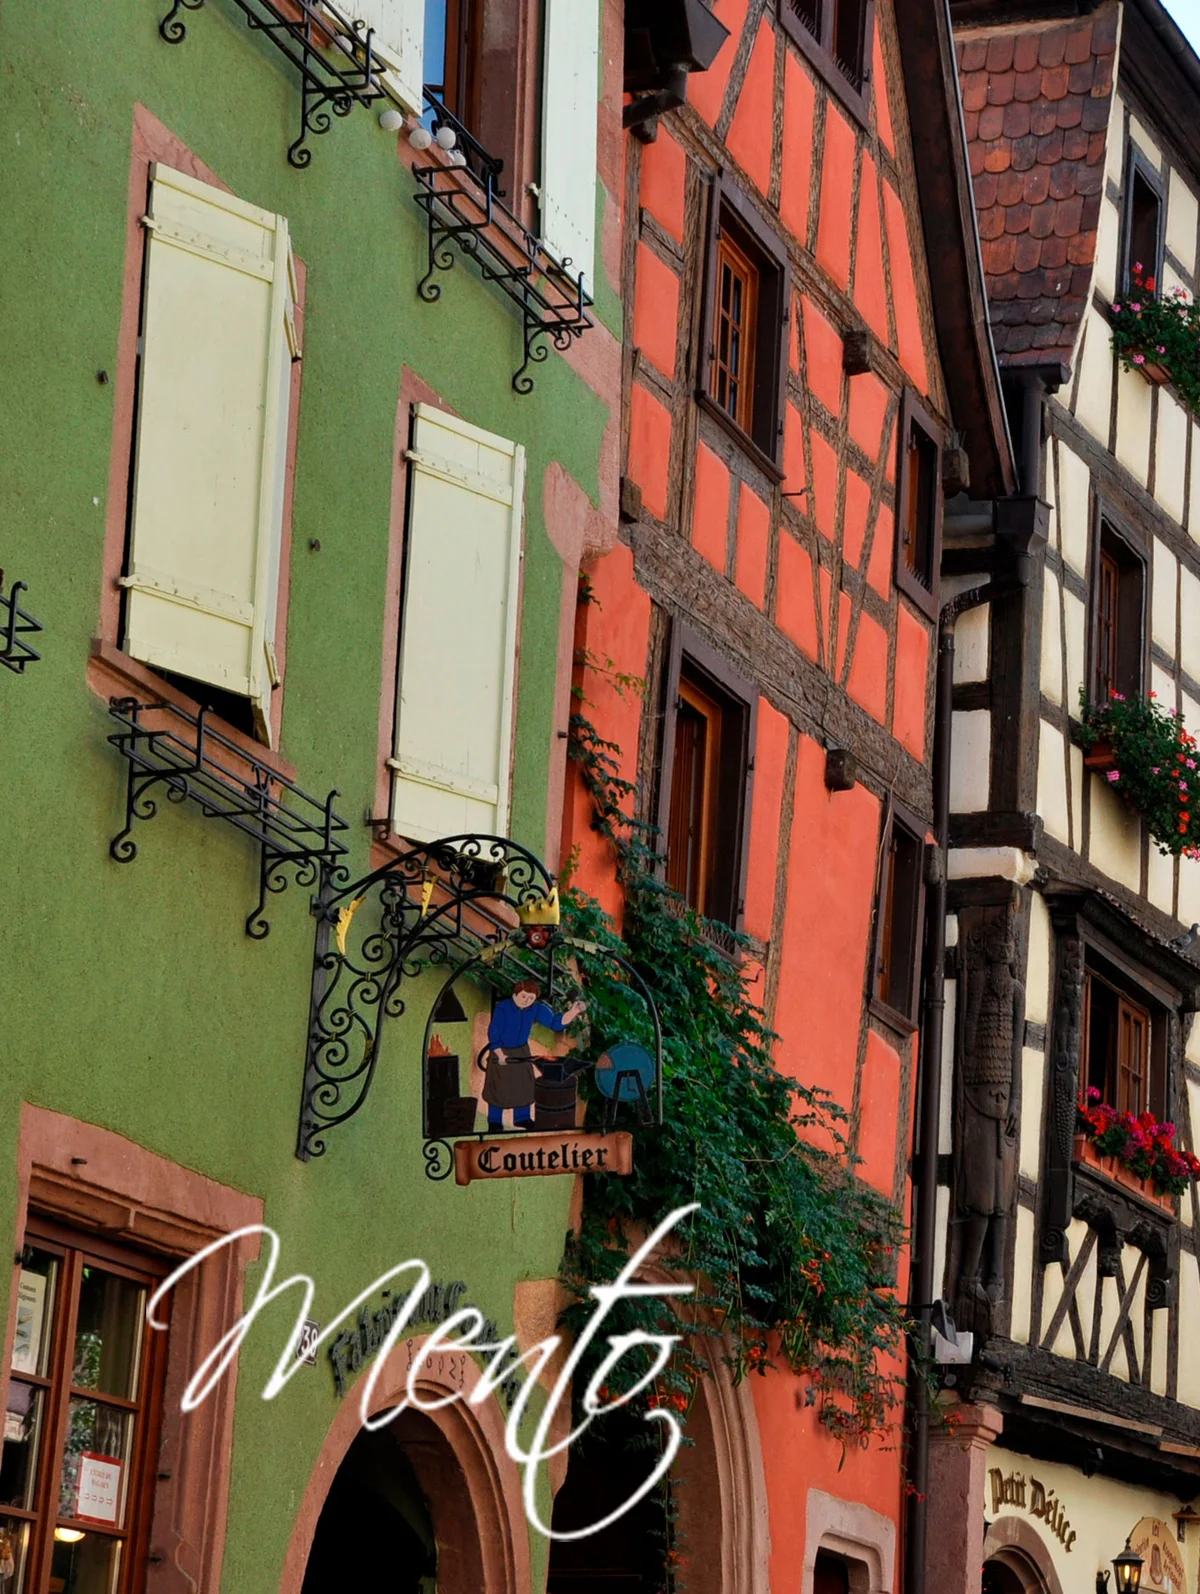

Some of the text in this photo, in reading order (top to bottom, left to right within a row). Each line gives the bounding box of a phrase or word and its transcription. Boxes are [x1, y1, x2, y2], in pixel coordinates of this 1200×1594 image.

[477, 1142, 608, 1174] Coutelier
[988, 1467, 1077, 1554] Petit Délice
